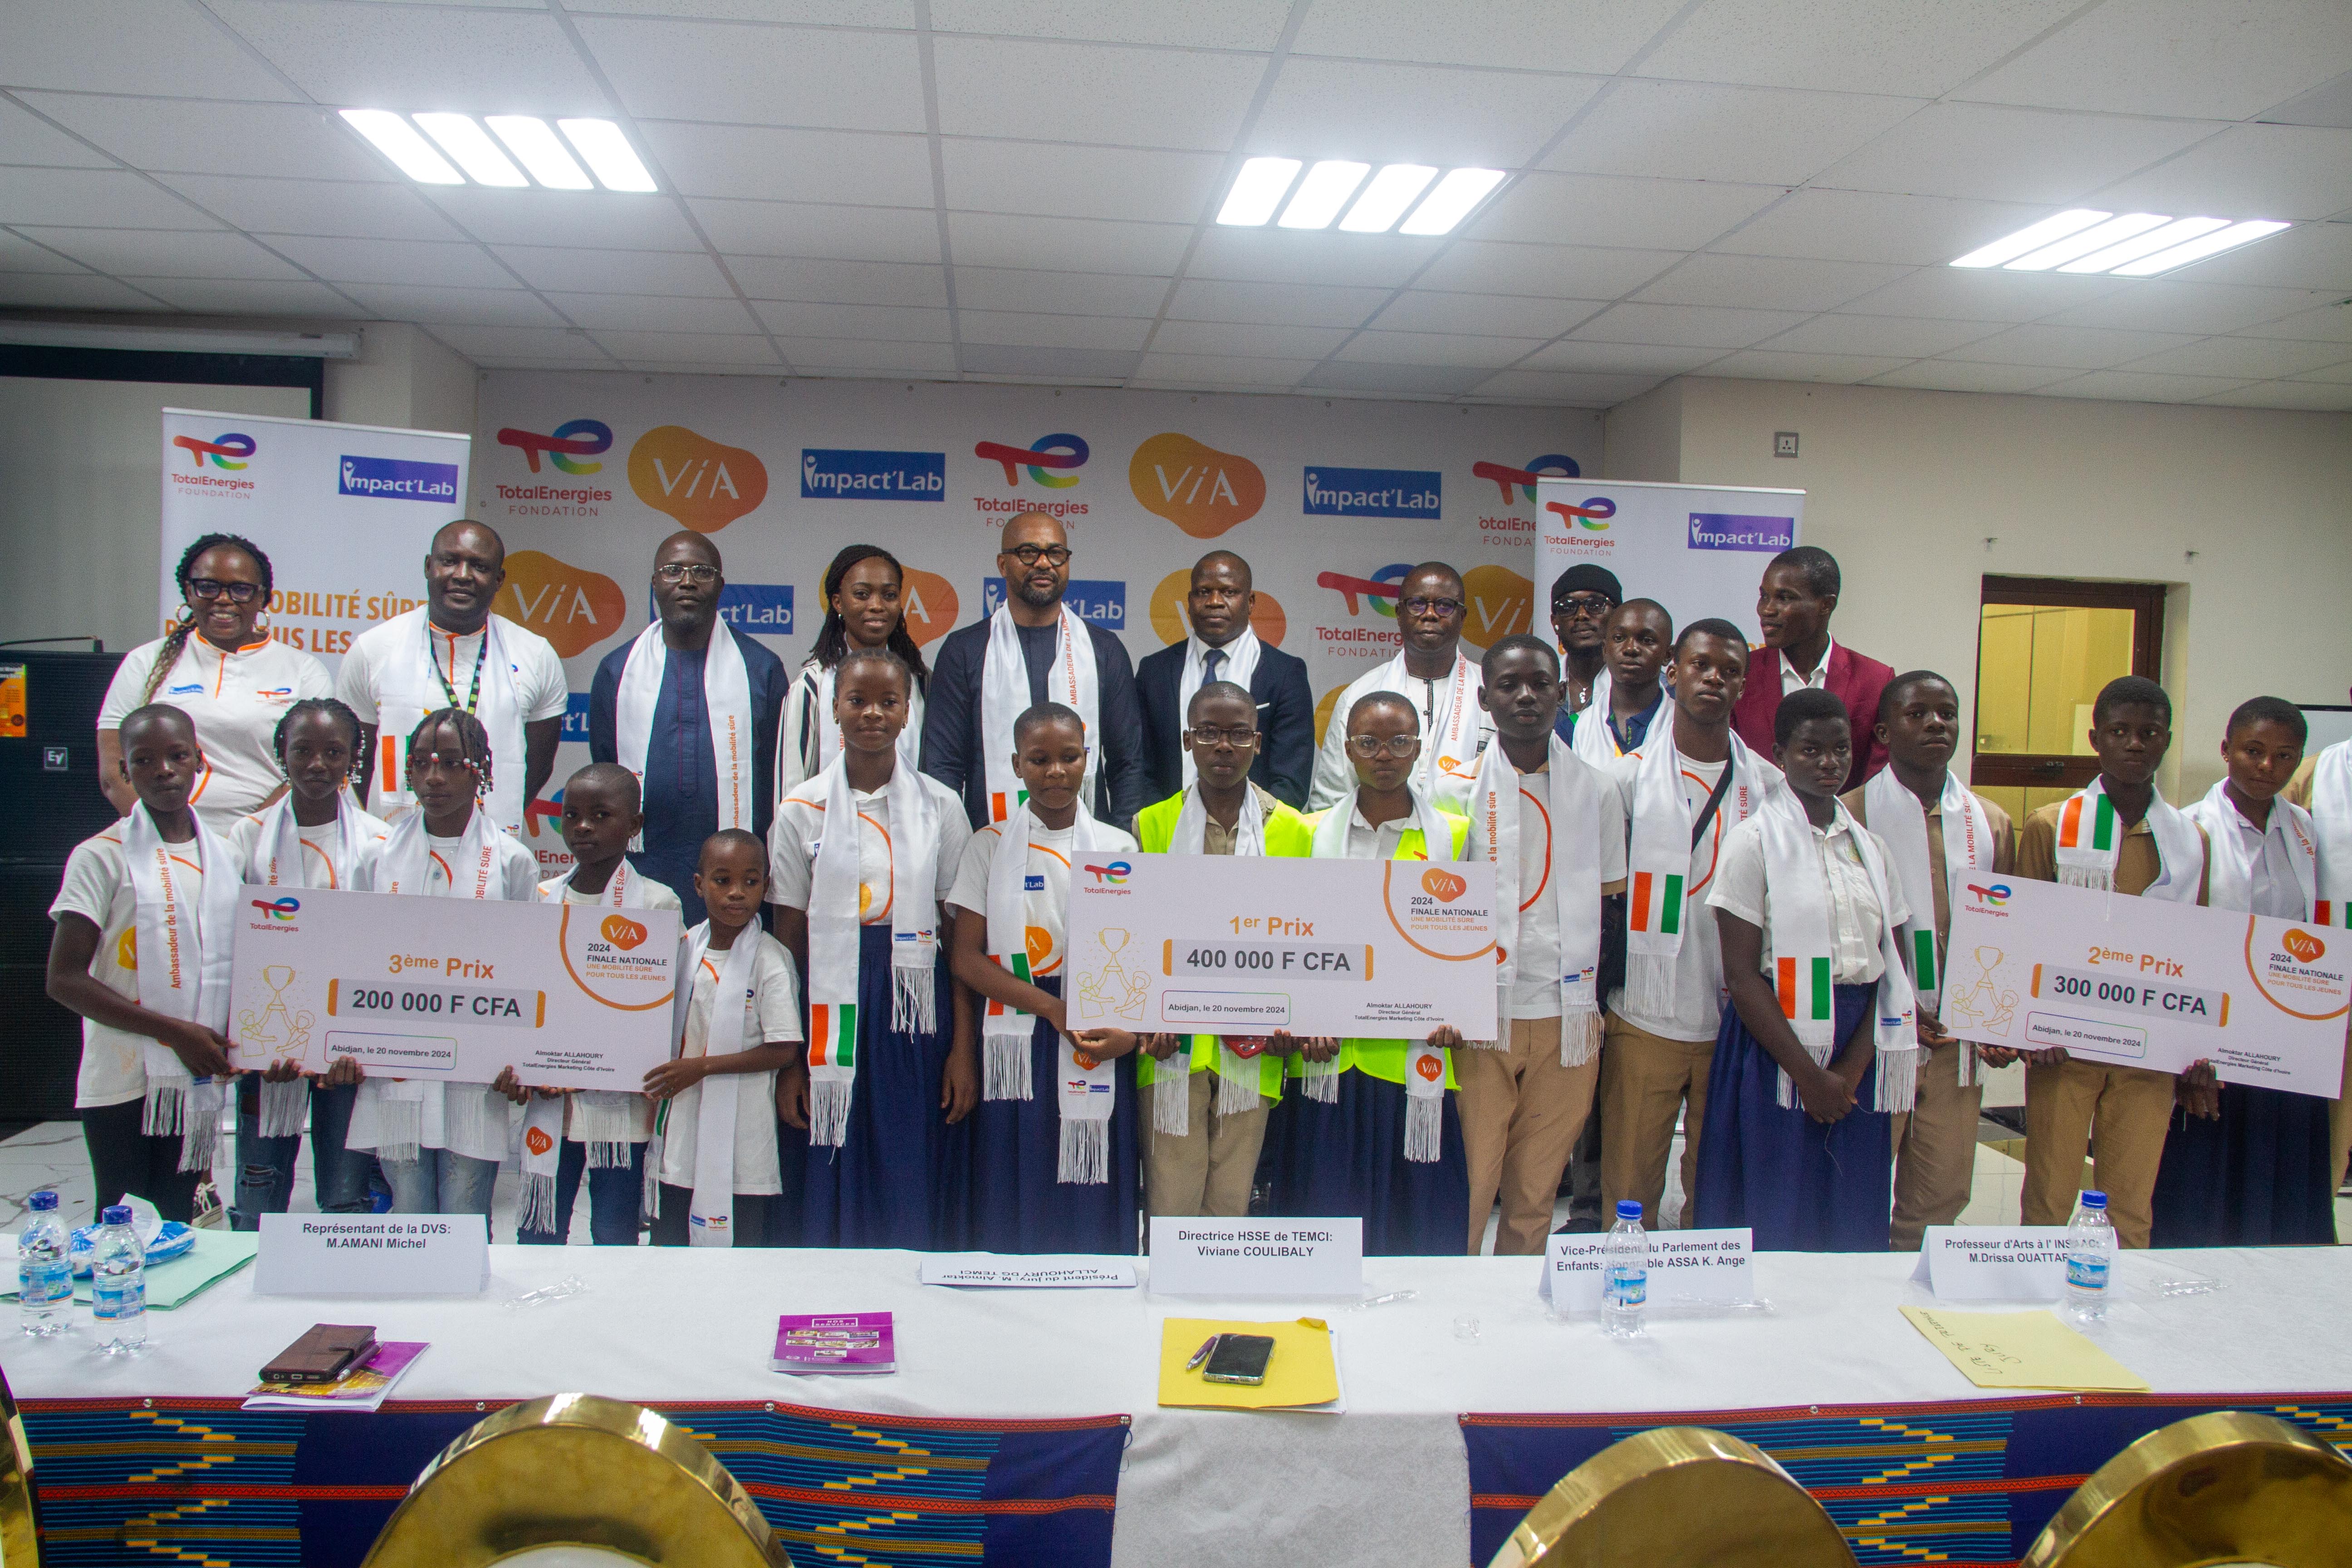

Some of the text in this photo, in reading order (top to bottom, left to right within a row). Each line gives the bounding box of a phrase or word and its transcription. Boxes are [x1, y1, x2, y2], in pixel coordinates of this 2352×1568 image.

[172, 473, 255, 490] TotalEnergies
[178, 487, 251, 500] FOUNDATION
[496, 485, 612, 504] TotalEnergies
[509, 505, 598, 516] FONDATION
[974, 498, 1088, 516] TotalEnergies
[1484, 536, 1533, 546] FONDA
[1545, 535, 1615, 547] TotalEnergies
[1550, 548, 1612, 556] FOUNDATION
[269, 589, 360, 619] OBILITÉ
[311, 628, 352, 655] LES
[1064, 632, 1071, 641] LA
[1316, 627, 1403, 646] TotalEnerg
[1065, 642, 1071, 652] DE
[1066, 653, 1078, 705] AMBASSADEUR
[1451, 696, 1463, 741] AMBASSADEUR
[730, 733, 738, 761] mobilité
[731, 772, 738, 780] de
[1487, 792, 1495, 809] sûre
[1487, 811, 1497, 844] mobilité
[1964, 816, 1975, 853] MOBILITÉ
[479, 846, 491, 867] SÛRE
[1968, 855, 1975, 865] LA
[1084, 887, 1131, 896] TotalEnergies
[1411, 897, 1433, 905] 2024
[1965, 905, 2009, 917] TotalEnergies
[157, 848, 181, 989] Ambassadeur de la mobilité sûre
[250, 923, 299, 932] TotalEnergies
[1230, 916, 1314, 936] 1er Prix
[588, 943, 610, 952] 2024
[619, 956, 667, 966] NATIONALE
[1187, 949, 1351, 971] 400 000 F CFA
[2087, 946, 2184, 978] 2ème Prix
[2270, 953, 2291, 963] 2024
[389, 955, 494, 980] 3ème Prix
[602, 963, 633, 972] MOBILITÉ
[635, 964, 653, 972] SÛRE
[2269, 964, 2343, 981] FINALE NATIONALE
[2054, 975, 2207, 1016] 300 000 F CFA
[353, 990, 521, 1017] 200 000 F CFA
[1168, 1004, 1200, 1012] Abidjan,
[1224, 1005, 1264, 1013] novembre
[2032, 1024, 2062, 1035] Abidjan,
[2083, 1032, 2121, 1044] novembre
[2123, 1039, 2141, 1047] 2024
[332, 1045, 365, 1054] Abidjan,
[388, 1048, 429, 1057] novembre
[303, 1223, 451, 1236] Représentant de la DVS:
[1179, 1230, 1333, 1242] Directrice HSSE de TEMCI:
[327, 1238, 426, 1248] M.AMANI Michel
[1662, 1242, 1718, 1253] Parlement
[1721, 1241, 1740, 1250] des
[1945, 1239, 2051, 1249] Professeur d'Arts à l'
[1198, 1246, 1314, 1256] Viviane COULIBALY
[1557, 1256, 1745, 1271] Enfants: ASSA K. Ange
[1969, 1253, 2068, 1263] M.Drissa OUATTAR
